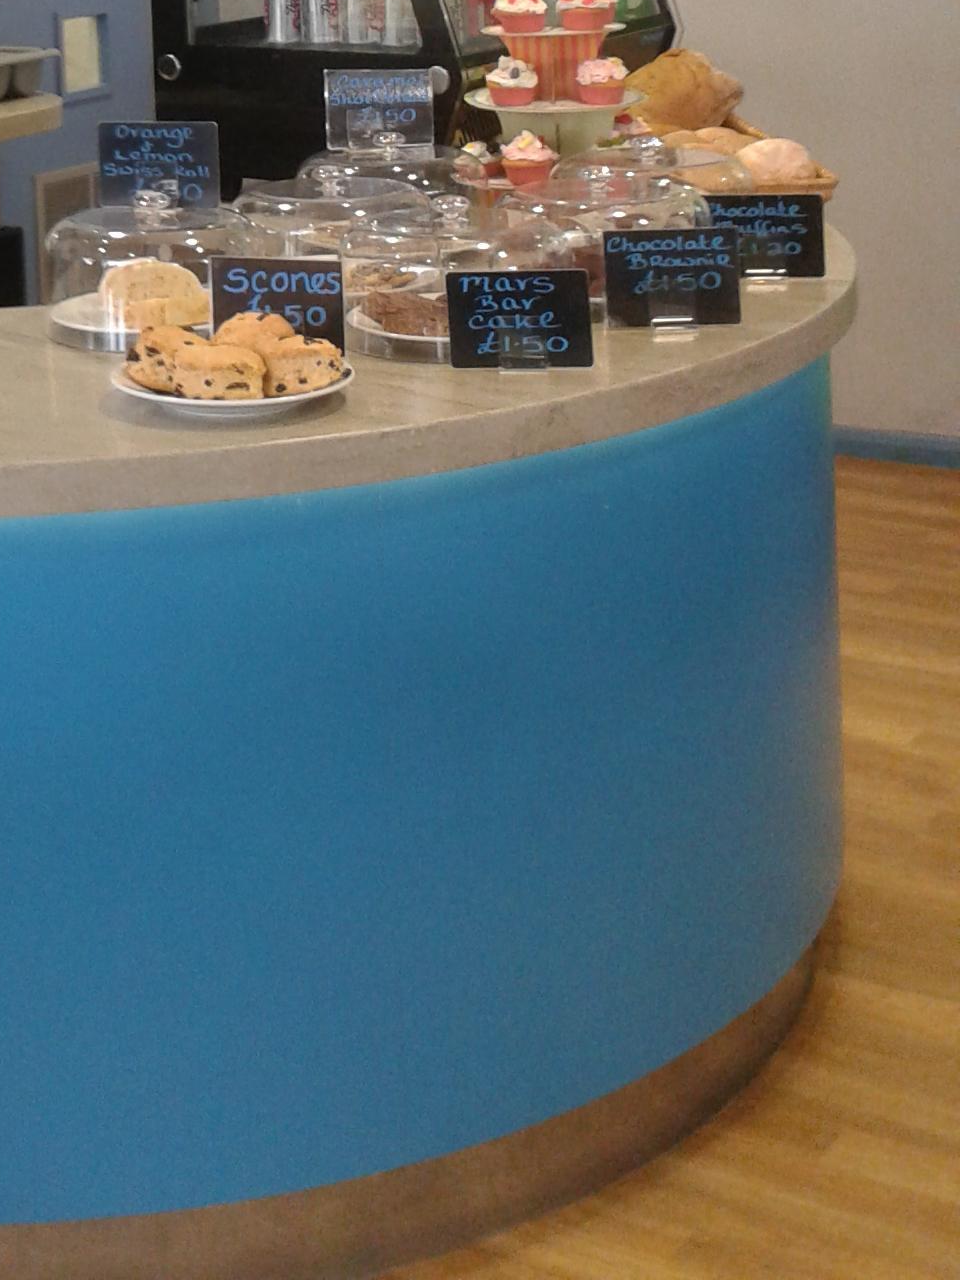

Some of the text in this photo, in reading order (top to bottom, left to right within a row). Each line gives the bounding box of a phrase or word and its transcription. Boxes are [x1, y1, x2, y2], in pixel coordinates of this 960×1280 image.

[114, 125, 193, 149] Orange
[114, 150, 193, 163] Lemon
[606, 234, 733, 254] Chocolate
[223, 267, 341, 295] Scones
[459, 275, 556, 293] Mars
[473, 294, 541, 313] Bar
[477, 331, 569, 354] £1.50
